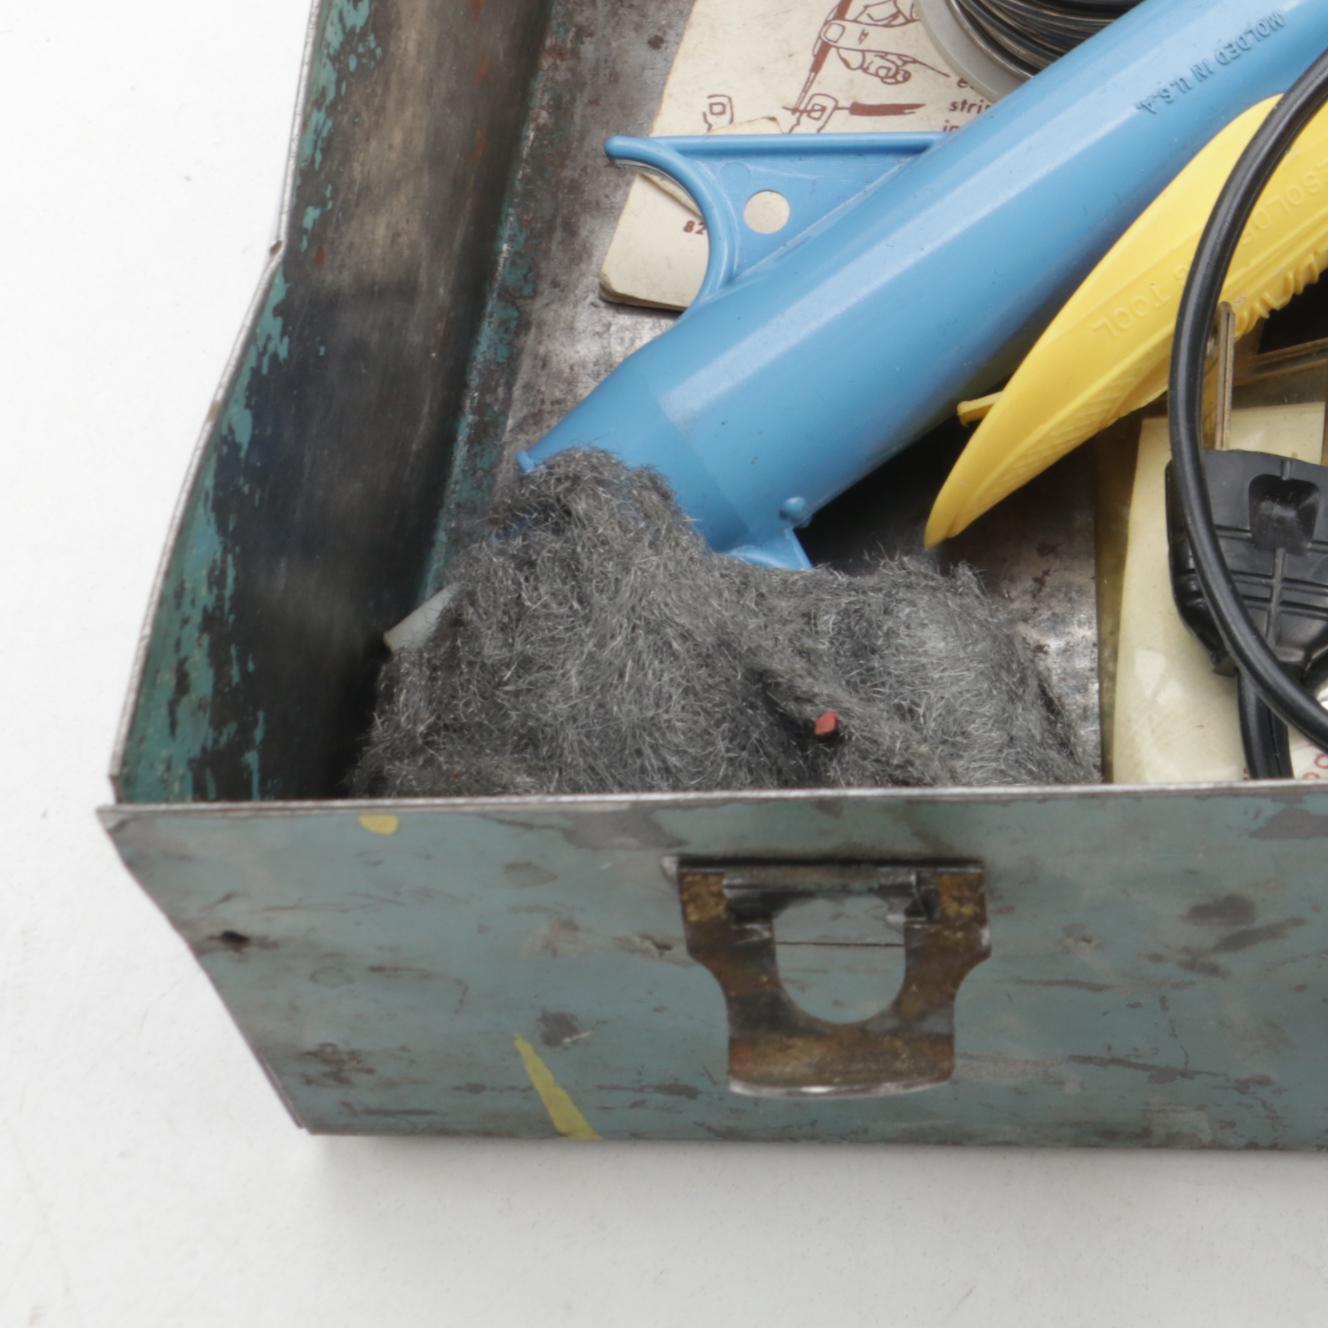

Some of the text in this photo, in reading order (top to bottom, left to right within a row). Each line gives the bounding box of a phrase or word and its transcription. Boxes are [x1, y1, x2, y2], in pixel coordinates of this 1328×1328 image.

[1215, 9, 1287, 66] MOLDED
[1189, 58, 1215, 82] IN
[1094, 281, 1172, 336] TOOL
